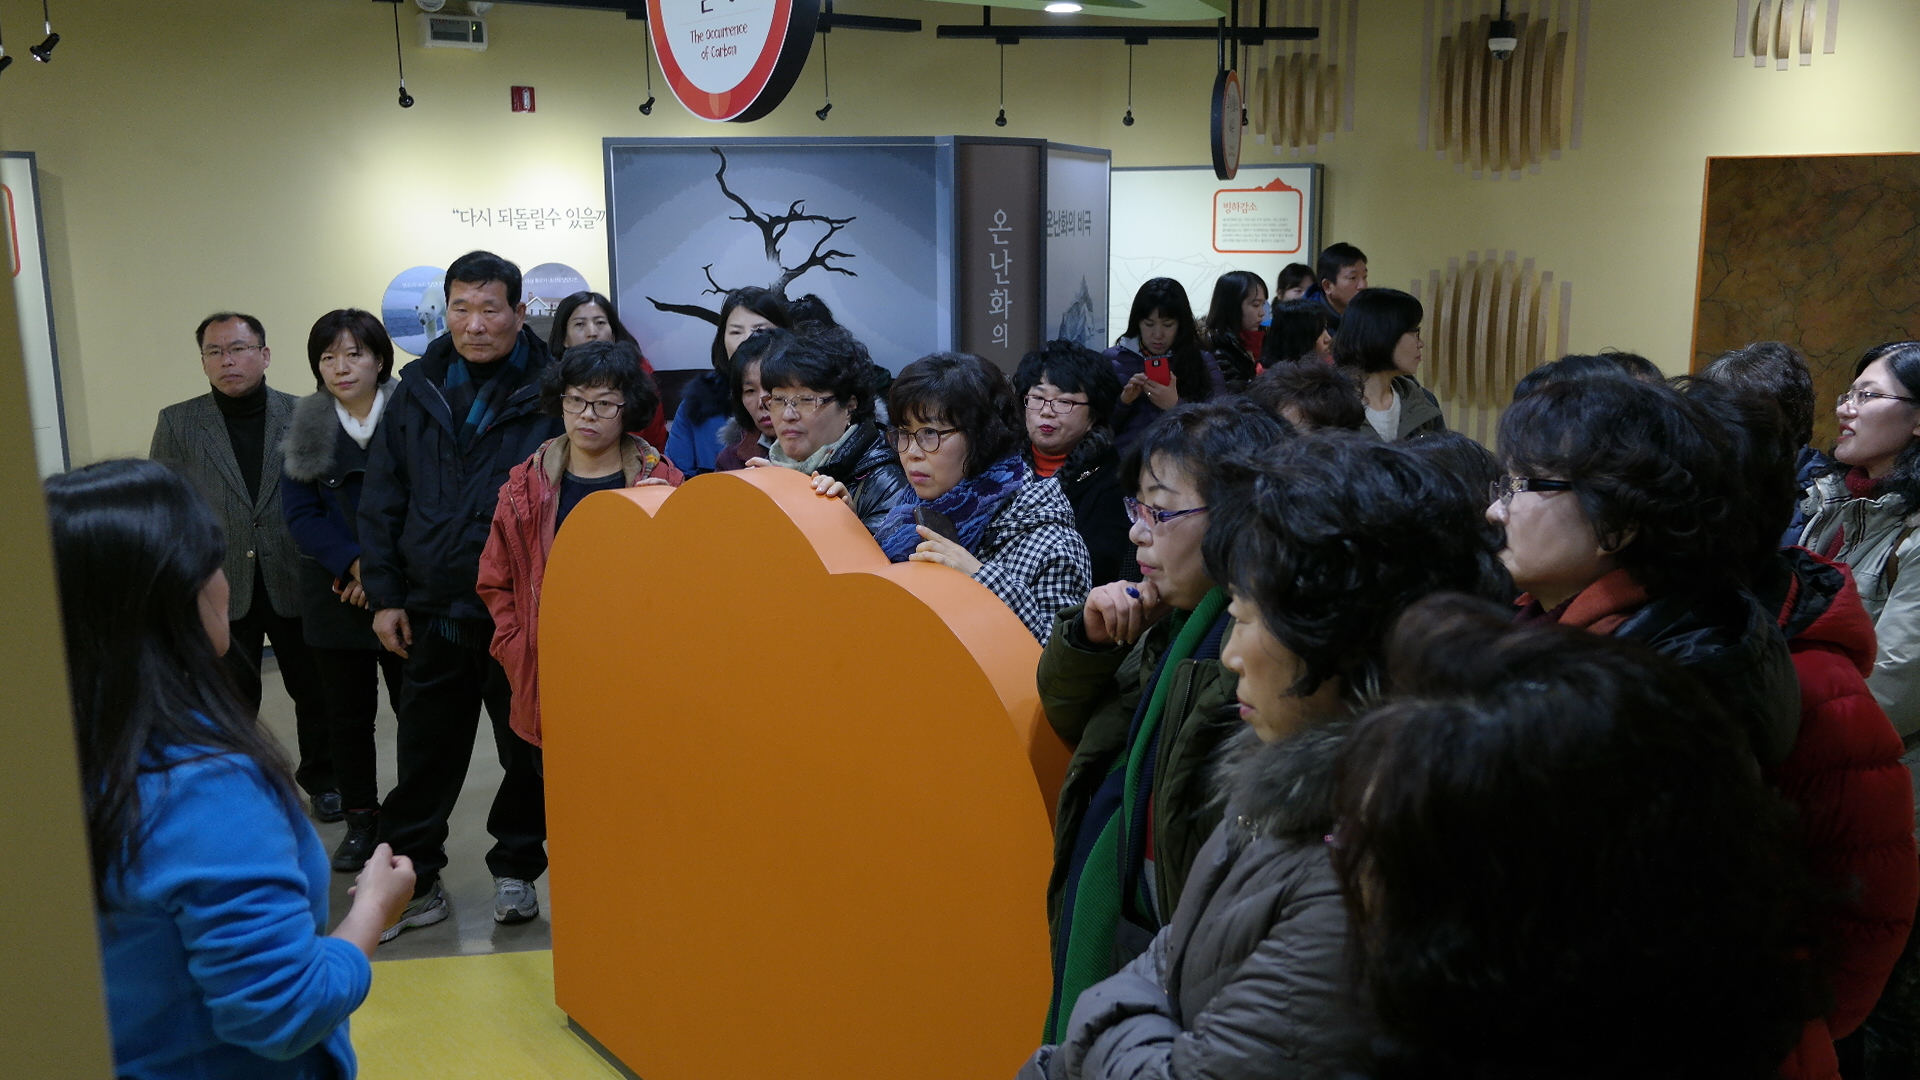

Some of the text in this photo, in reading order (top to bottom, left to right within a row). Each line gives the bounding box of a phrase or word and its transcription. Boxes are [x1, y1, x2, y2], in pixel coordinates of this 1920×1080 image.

[690, 29, 703, 44] The
[701, 43, 737, 60] of Carbon
[1223, 202, 1258, 214] 빙하감소
[498, 208, 562, 230] 되돌릴수
[1047, 210, 1091, 237] 온난화의 비극
[988, 209, 1013, 348] 온난화의
